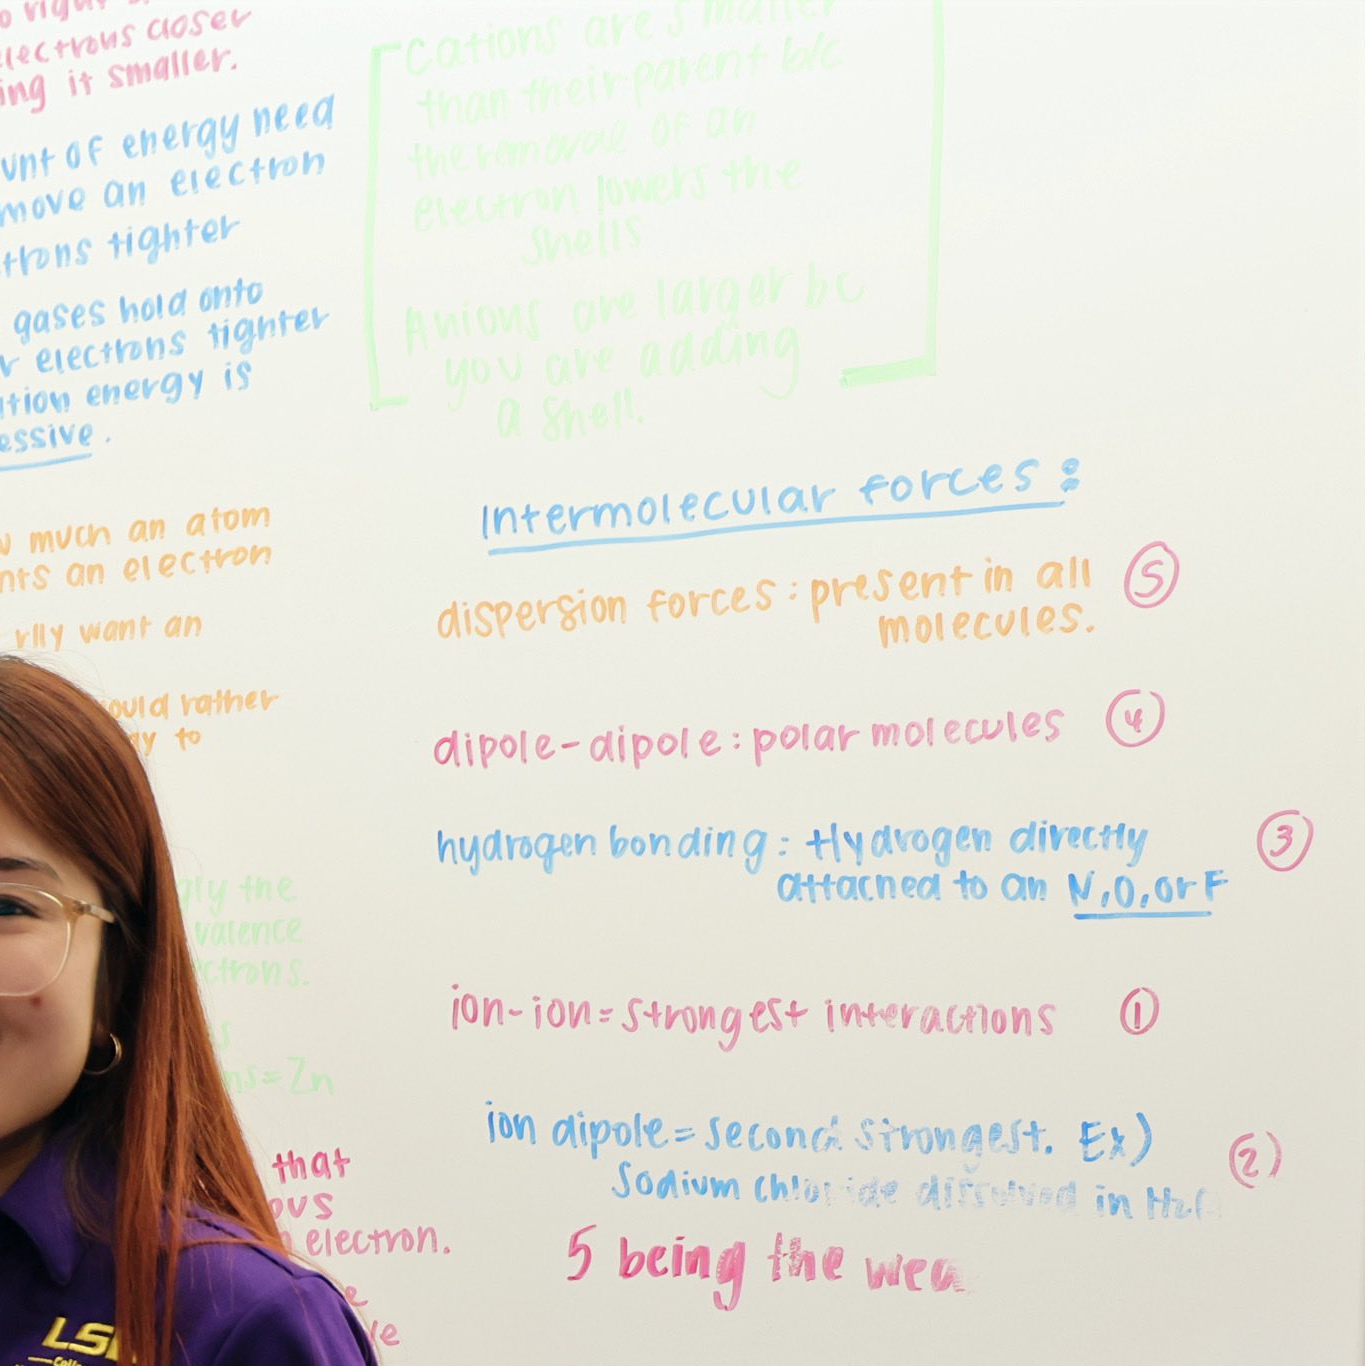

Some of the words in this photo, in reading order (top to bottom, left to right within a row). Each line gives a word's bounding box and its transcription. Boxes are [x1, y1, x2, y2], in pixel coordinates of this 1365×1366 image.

[147, 8, 253, 42] closer
[403, 15, 564, 76] Cations
[584, 9, 654, 51] are
[69, 69, 93, 97] it
[108, 46, 238, 89] smaller.
[416, 86, 510, 131] than
[522, 64, 628, 110] their
[631, 41, 767, 110] parent
[66, 134, 103, 169] of
[122, 112, 239, 159] energy
[253, 93, 335, 137] need
[407, 141, 465, 182] the
[705, 105, 757, 140] an
[103, 178, 146, 208] an
[170, 150, 325, 196] electron
[413, 181, 581, 233] electron
[597, 162, 709, 216] lowers
[722, 152, 805, 194] the
[107, 214, 240, 265] tighter
[521, 215, 644, 268] shells
[13, 299, 106, 346] gases
[119, 288, 187, 324] hold
[199, 277, 263, 313] onto
[404, 299, 541, 356] Anions
[573, 291, 638, 334] are
[656, 264, 790, 325] larger
[36, 329, 187, 373] electrons
[209, 306, 329, 355] tighter
[86, 368, 203, 405] energy
[224, 360, 252, 390] is
[445, 352, 523, 412] you
[545, 345, 613, 386] are
[639, 323, 801, 401] adding
[497, 397, 521, 438] a
[30, 523, 111, 554] much
[129, 517, 165, 543] an
[186, 505, 271, 537] atom
[481, 483, 836, 540] Intermolecular
[66, 561, 105, 587] an
[123, 543, 272, 582] electron
[437, 588, 627, 639] dispersion
[811, 560, 972, 624] present
[983, 556, 1014, 593] in
[1036, 556, 1091, 590] all
[80, 615, 152, 646] want
[165, 614, 202, 637] an
[879, 601, 1096, 649] molecules.
[181, 688, 279, 716] rather
[174, 727, 201, 750] to
[752, 722, 860, 768] polar
[871, 708, 1065, 748] molecules
[437, 829, 597, 876] hydrogen
[806, 821, 992, 867] Hydrogen
[1009, 820, 1149, 867] directly
[238, 875, 298, 902] the
[777, 869, 942, 904] attached
[953, 869, 988, 901] to
[1001, 873, 1047, 902] an
[195, 917, 304, 945] valence
[825, 998, 1057, 1037] interactions
[485, 1099, 537, 1146] ion
[272, 1147, 351, 1184] that
[1096, 1184, 1133, 1220] in
[306, 1225, 451, 1257] electron.
[566, 1223, 597, 1281] 5
[619, 1235, 746, 1312] being
[767, 1231, 844, 1282] the
